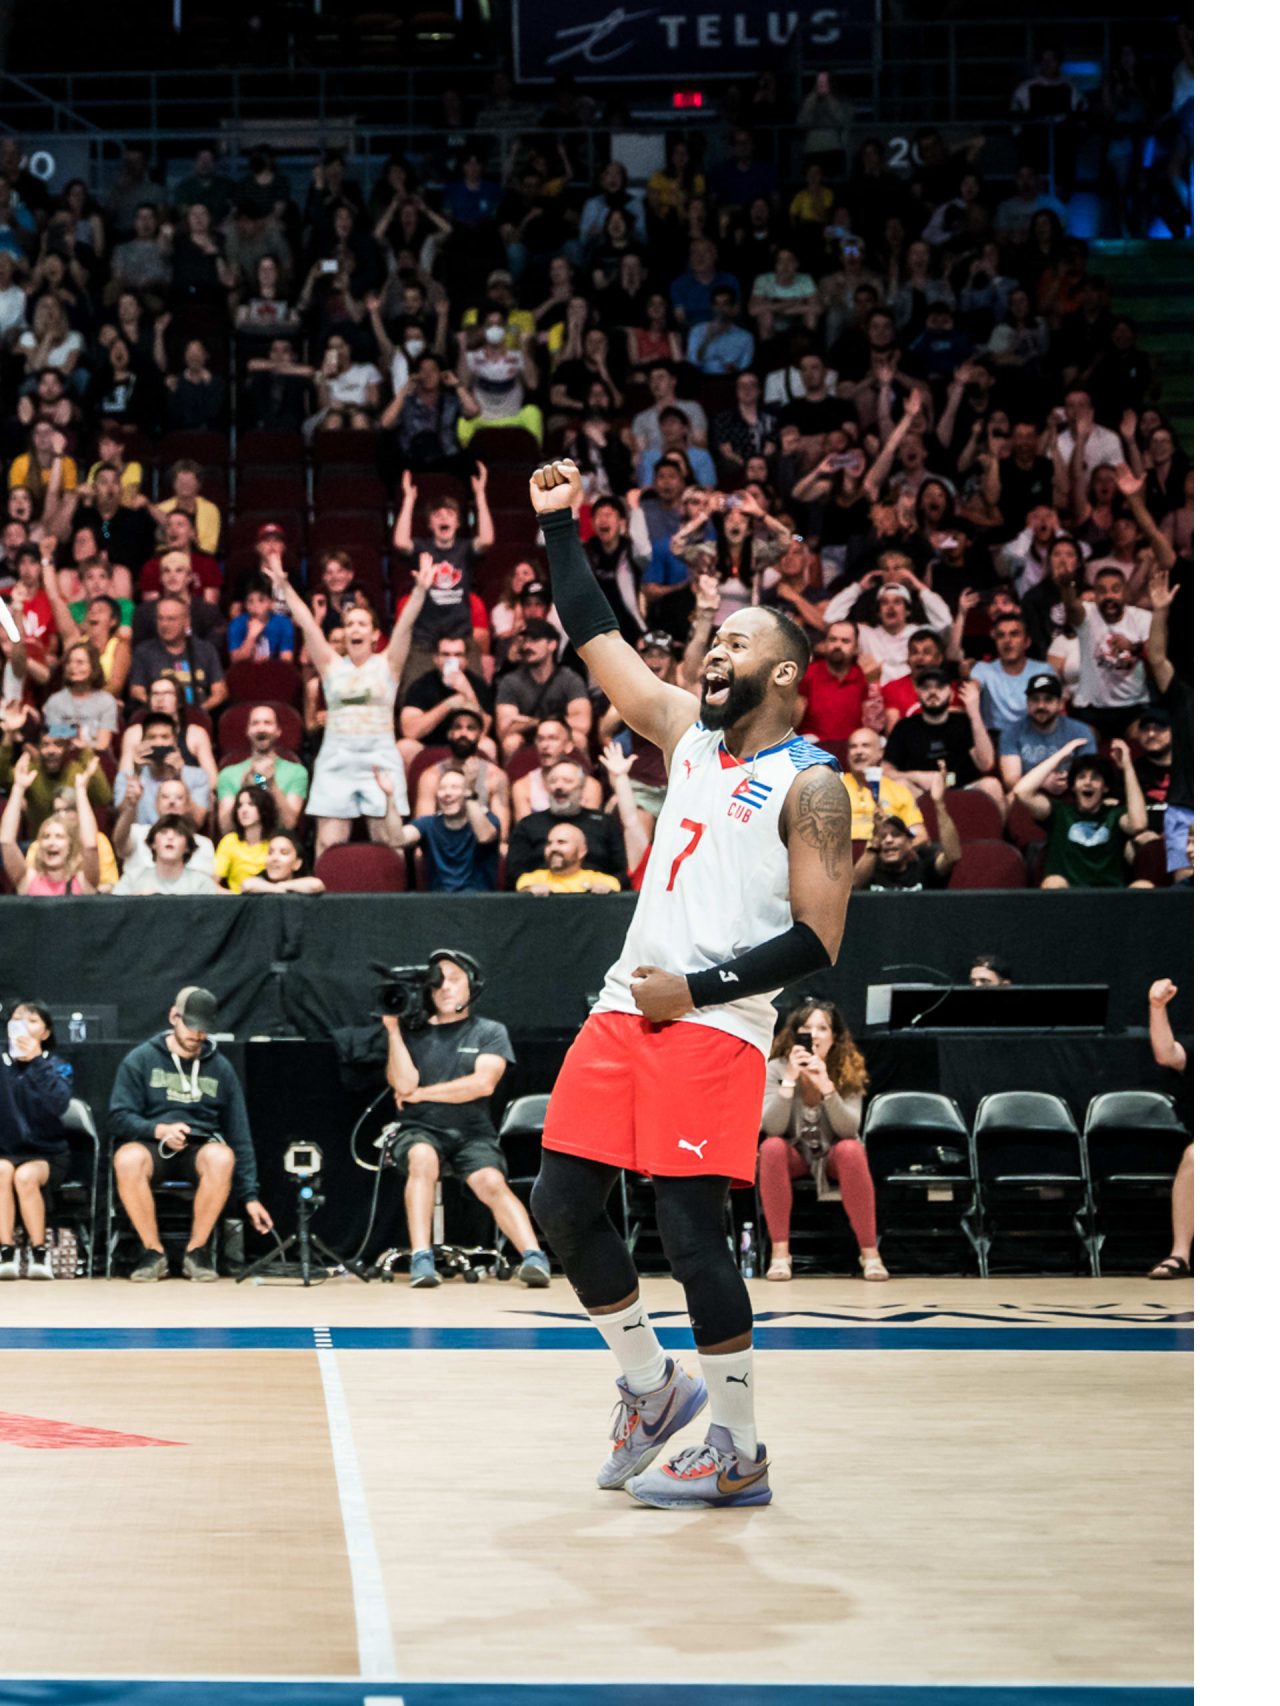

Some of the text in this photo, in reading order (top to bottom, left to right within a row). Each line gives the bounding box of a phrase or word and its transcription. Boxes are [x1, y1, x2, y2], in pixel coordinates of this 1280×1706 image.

[657, 8, 841, 49] TELUS
[727, 802, 753, 824] CUB
[666, 818, 706, 892] 7
